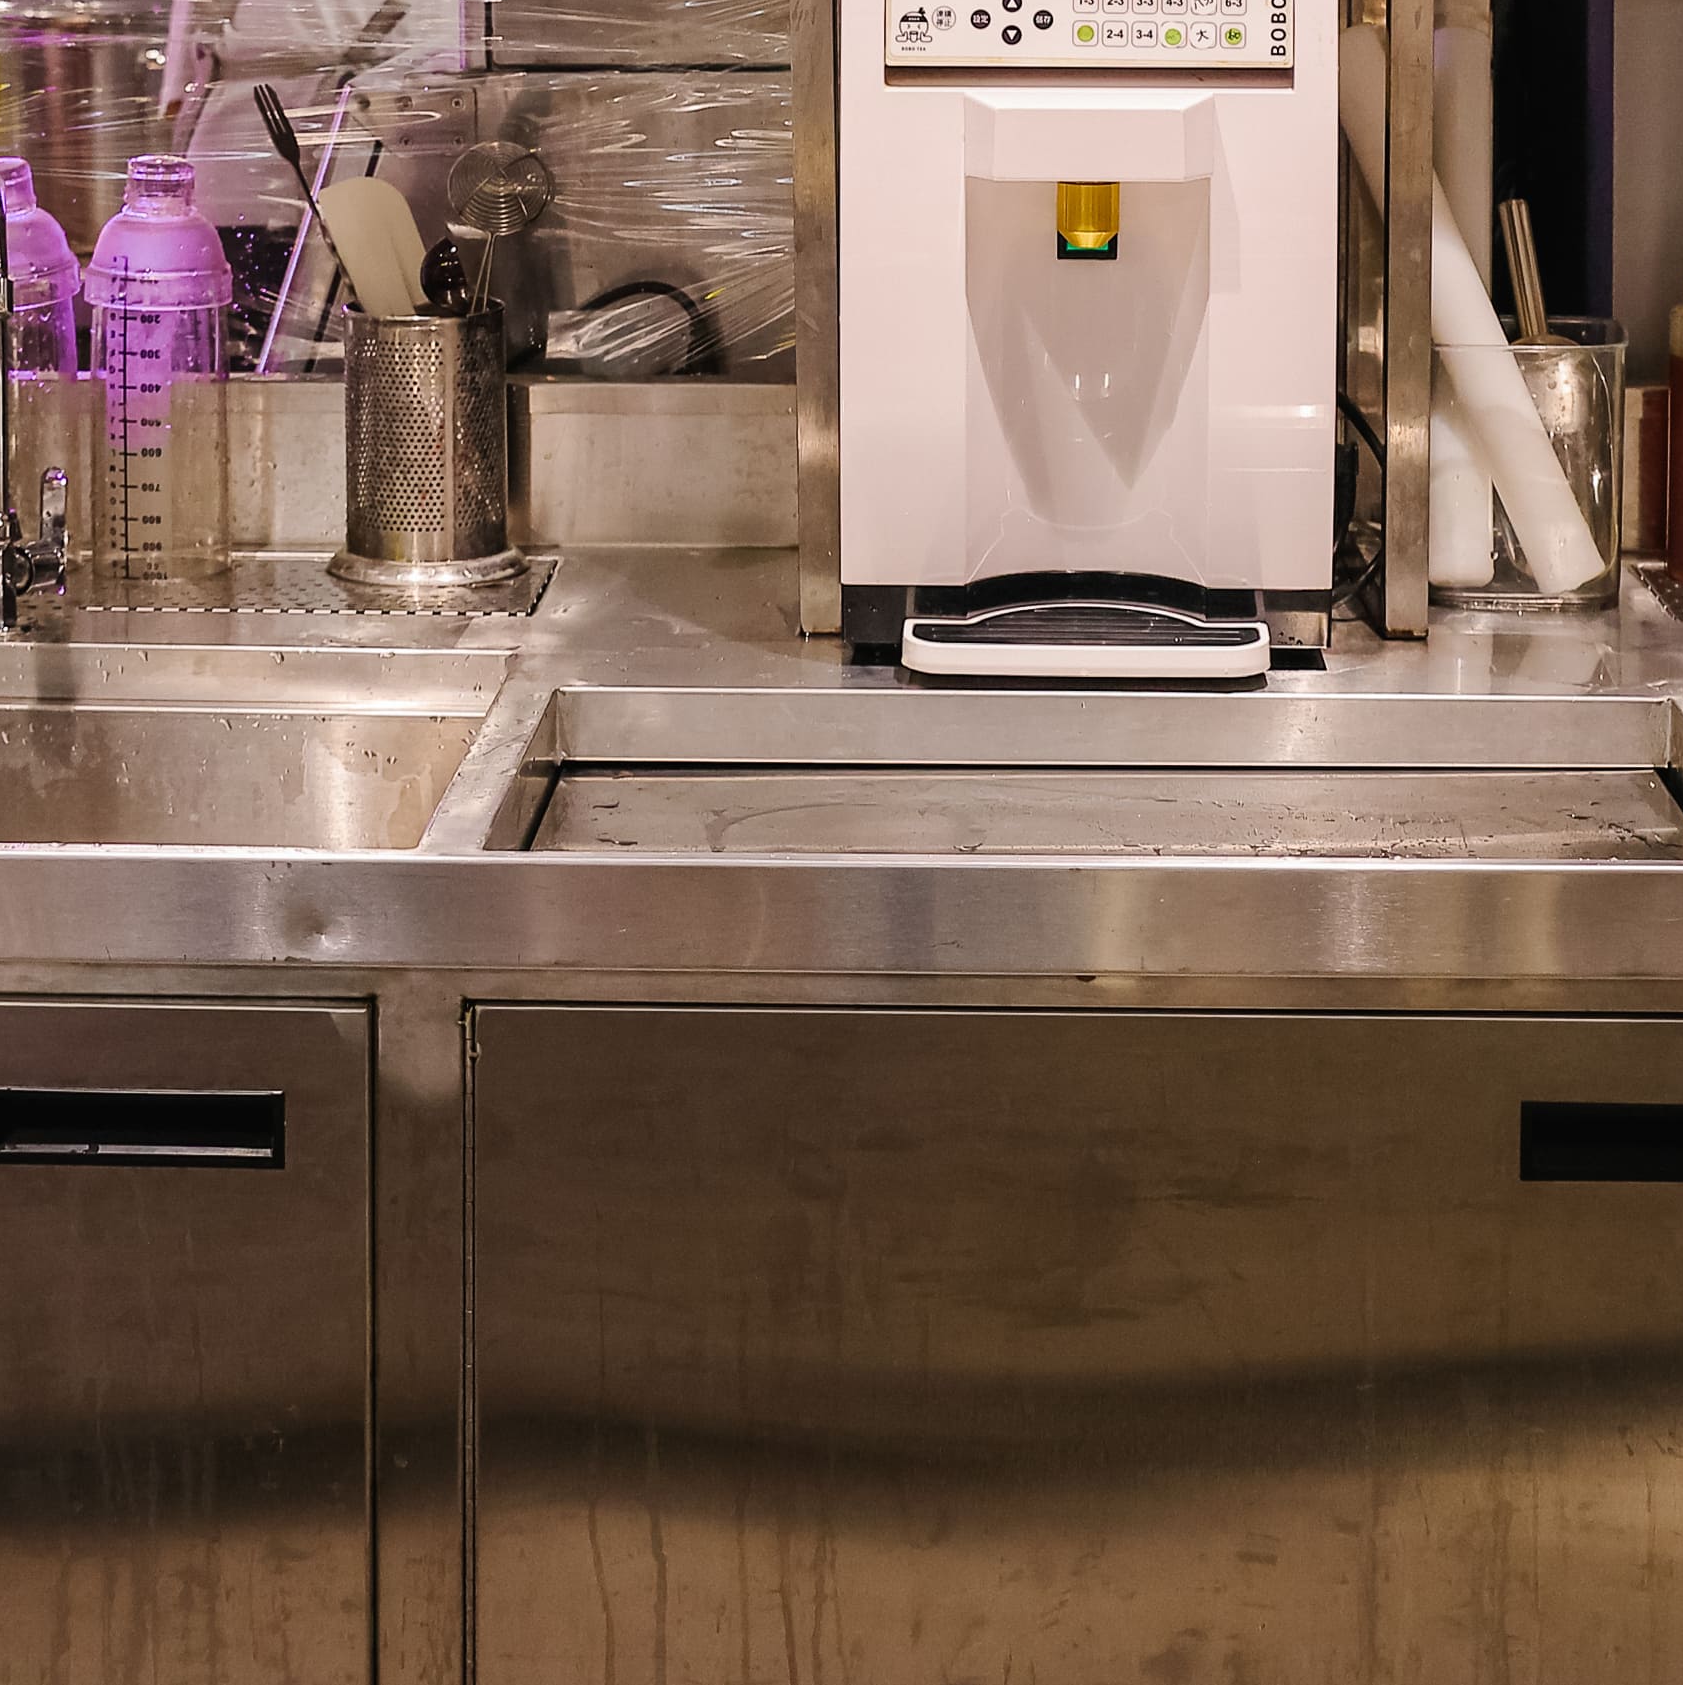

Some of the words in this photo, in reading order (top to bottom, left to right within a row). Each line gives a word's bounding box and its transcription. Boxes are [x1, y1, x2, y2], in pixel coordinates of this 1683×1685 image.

[1106, 29, 1124, 39] 2-4
[1136, 29, 1153, 39] 3-4
[140, 349, 161, 359] 300
[140, 383, 162, 393] 400
[141, 483, 161, 492] 700
